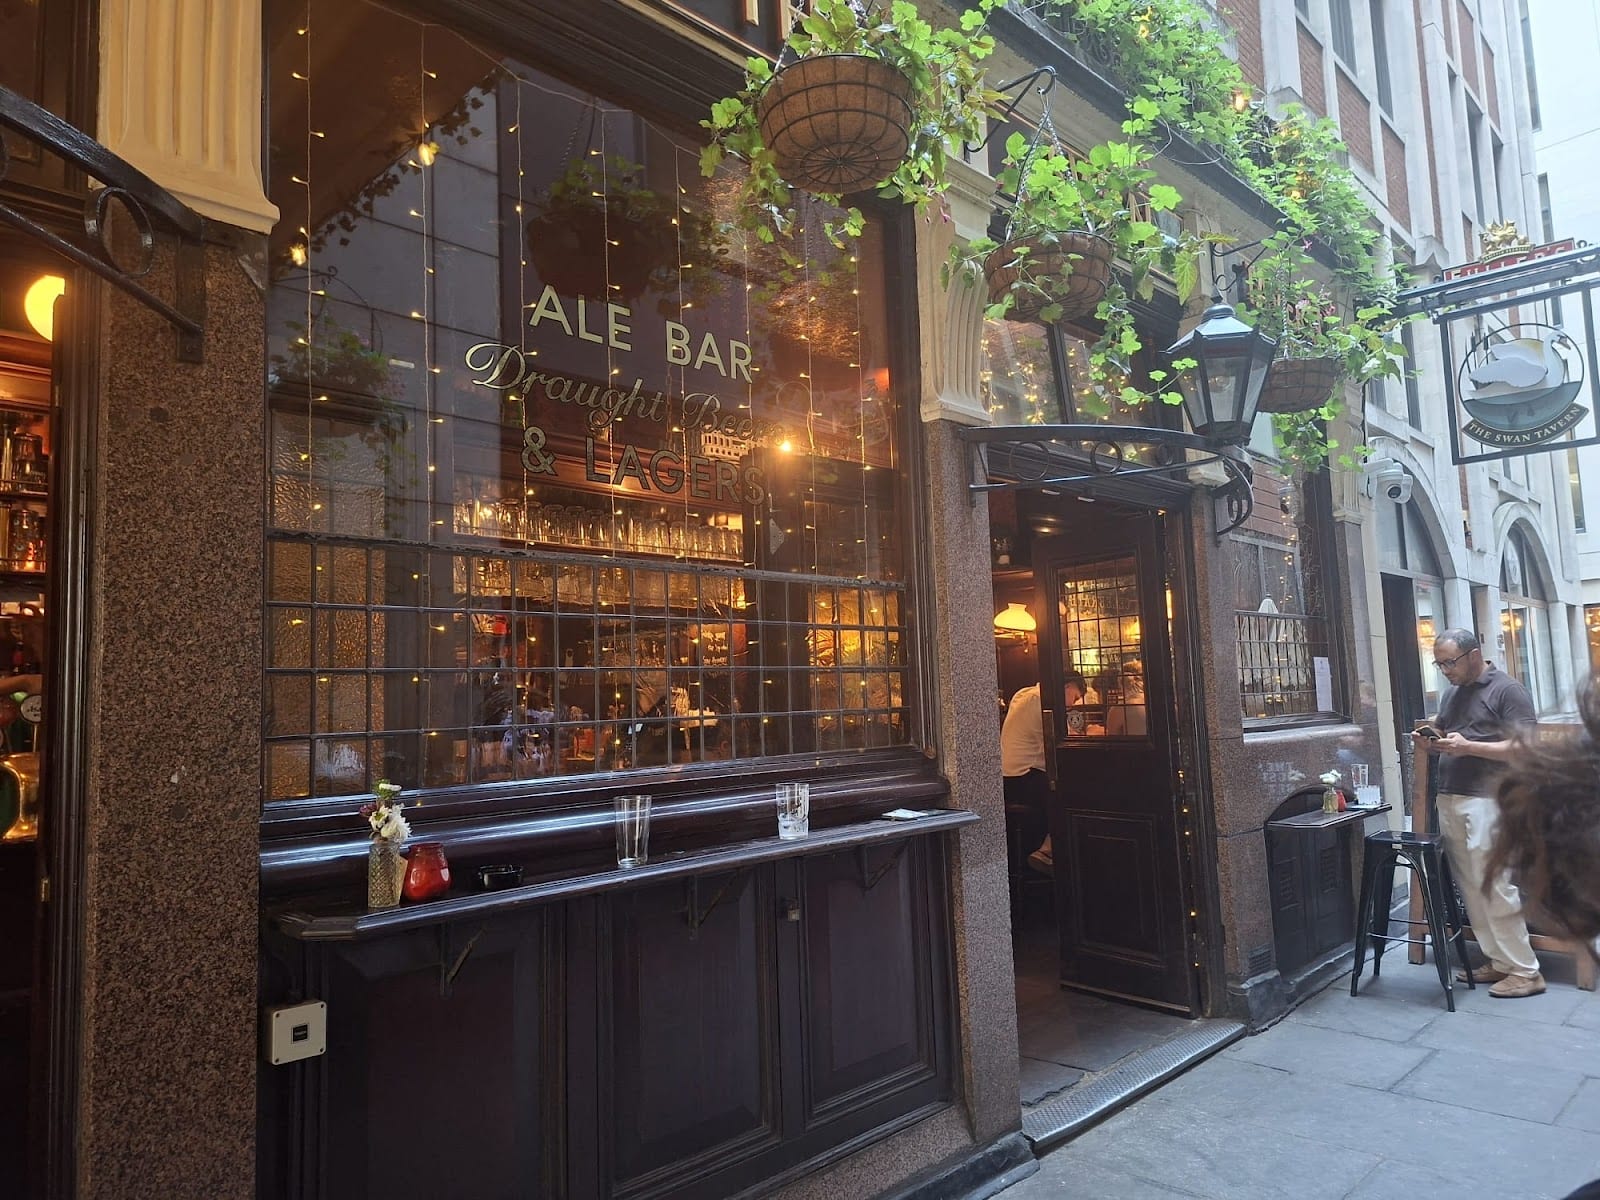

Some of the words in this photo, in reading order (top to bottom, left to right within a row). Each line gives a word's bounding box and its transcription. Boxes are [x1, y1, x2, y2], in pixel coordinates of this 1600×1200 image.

[529, 284, 632, 352] ALE
[665, 319, 753, 384] BAR
[465, 342, 665, 429] Draught
[1468, 422, 1492, 440] THE
[1494, 433, 1531, 443] SWAN
[1533, 406, 1581, 439] TAVERN
[520, 426, 557, 477] &
[584, 436, 769, 505] LAGERS
